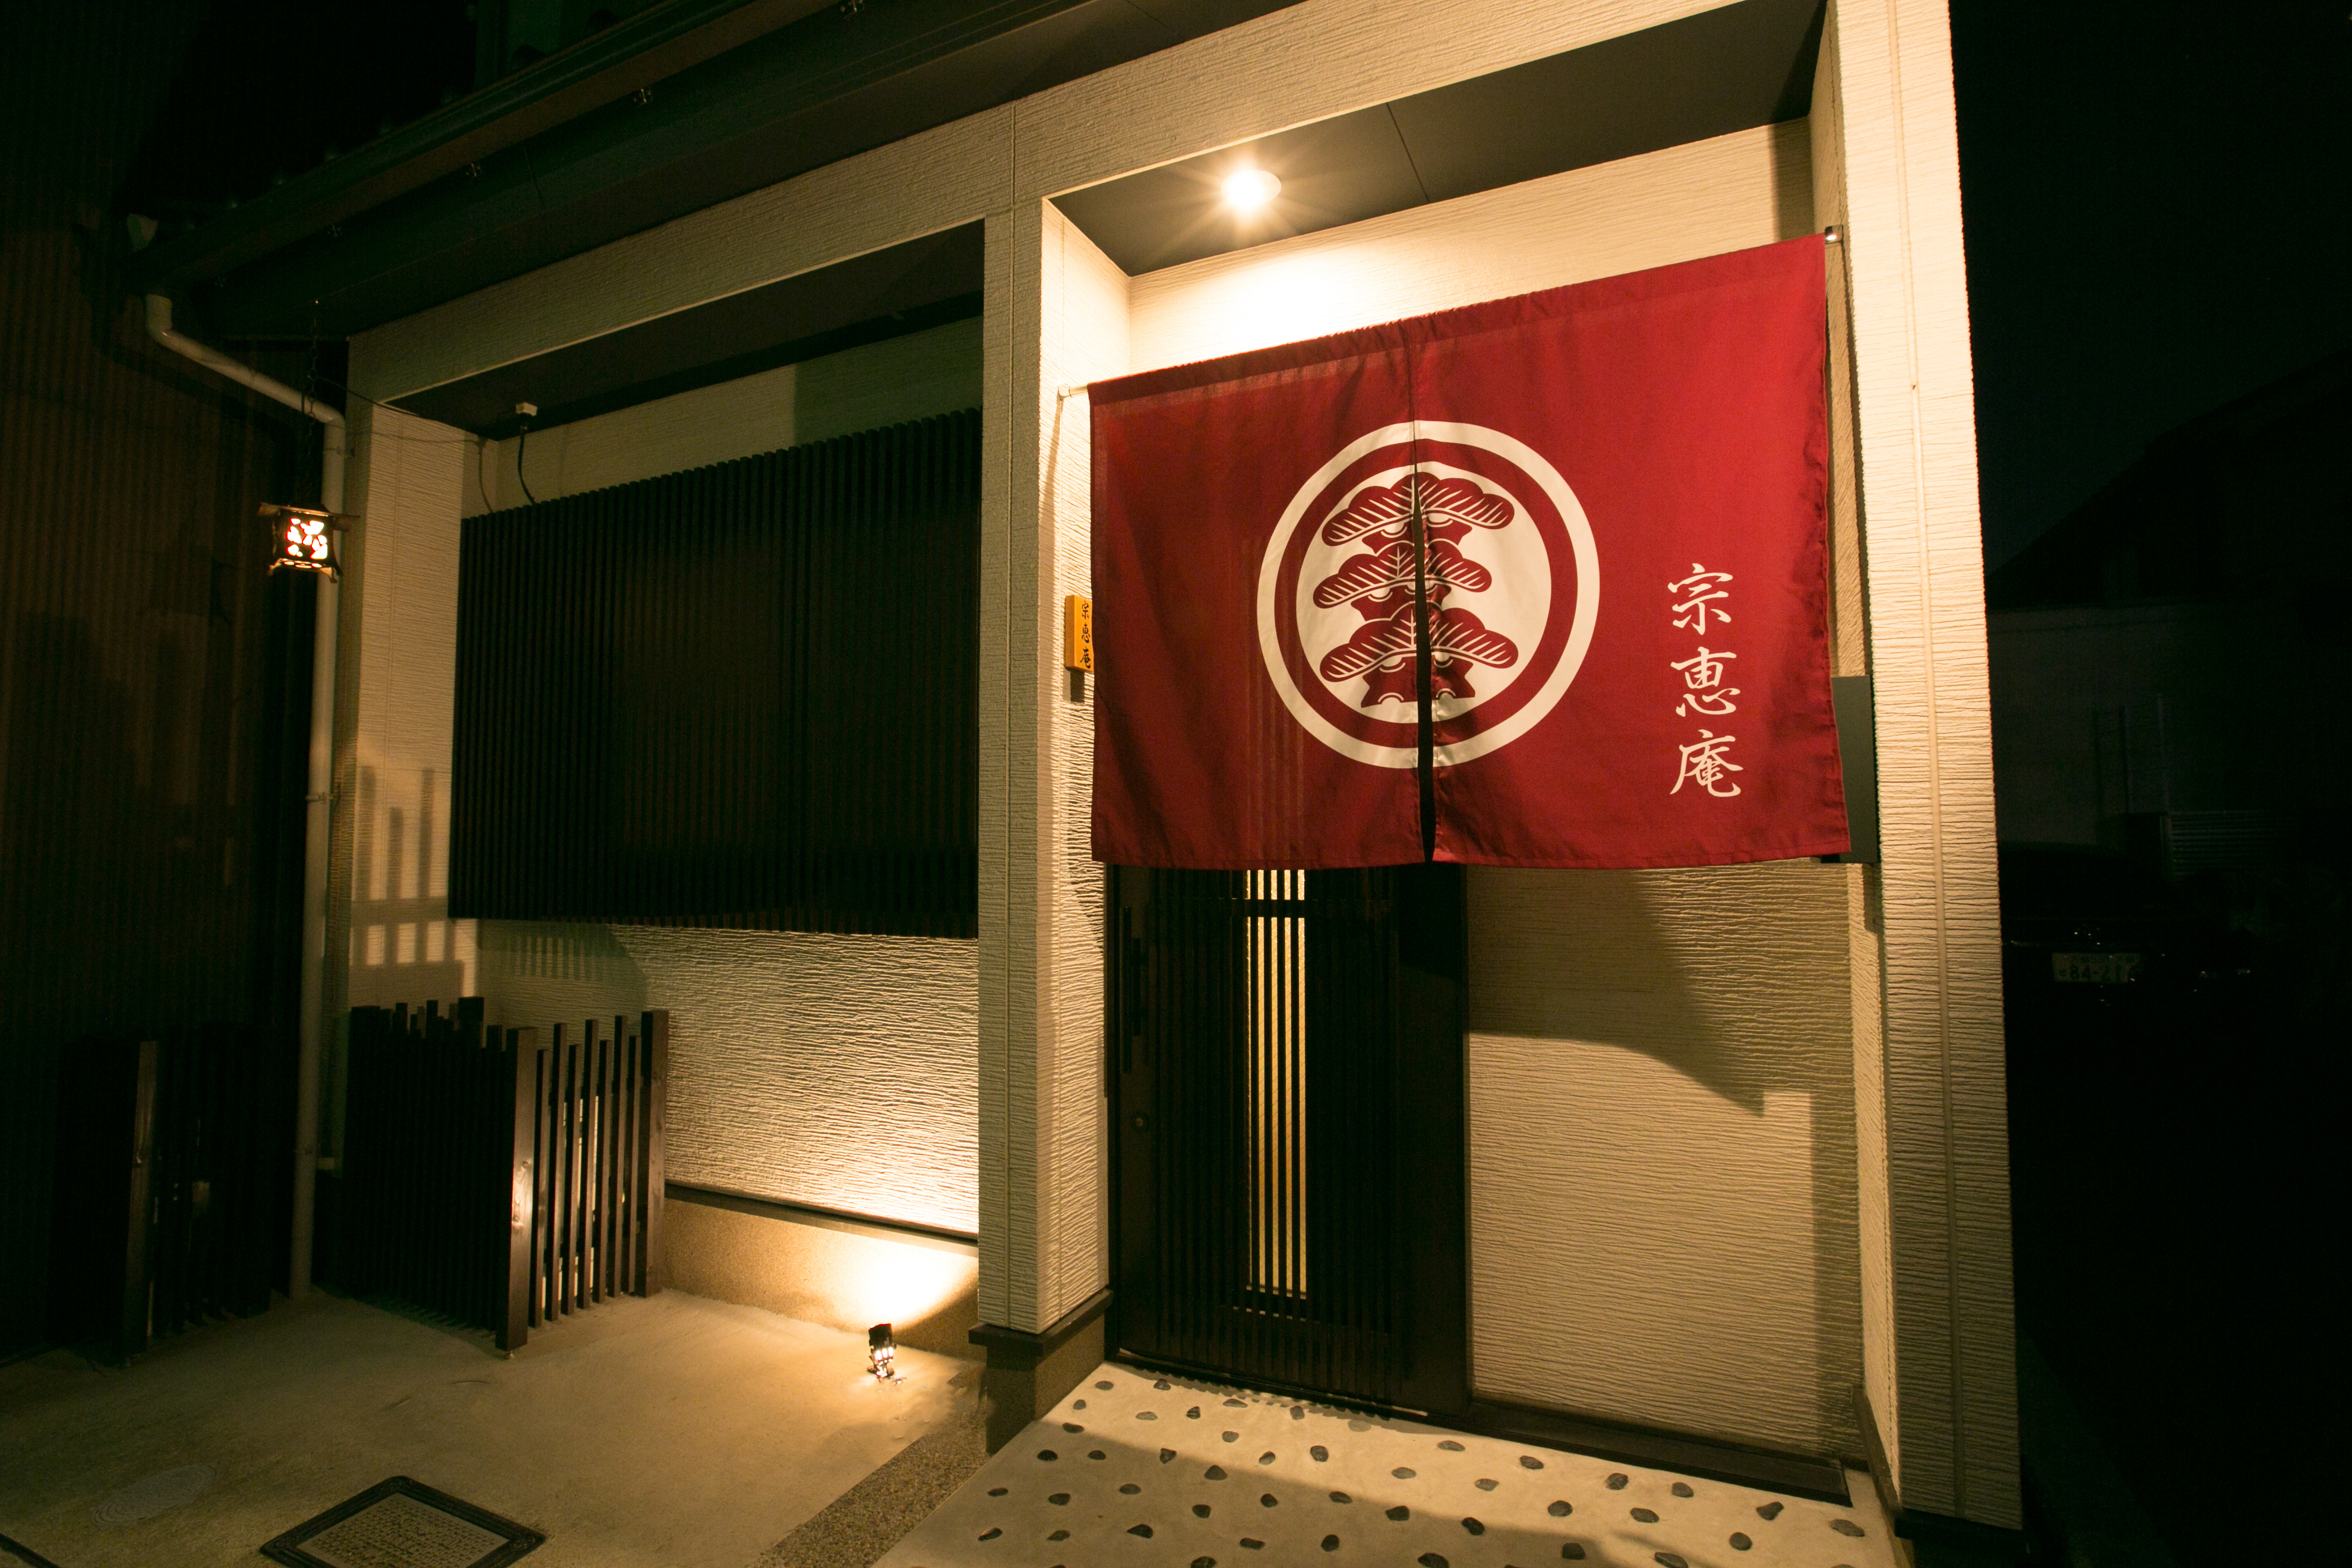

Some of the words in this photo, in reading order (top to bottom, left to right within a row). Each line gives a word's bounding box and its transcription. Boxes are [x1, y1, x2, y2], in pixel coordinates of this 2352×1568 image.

[1080, 600, 1091, 669] 宗恵庵
[1667, 562, 1744, 798] 宗恵庵
